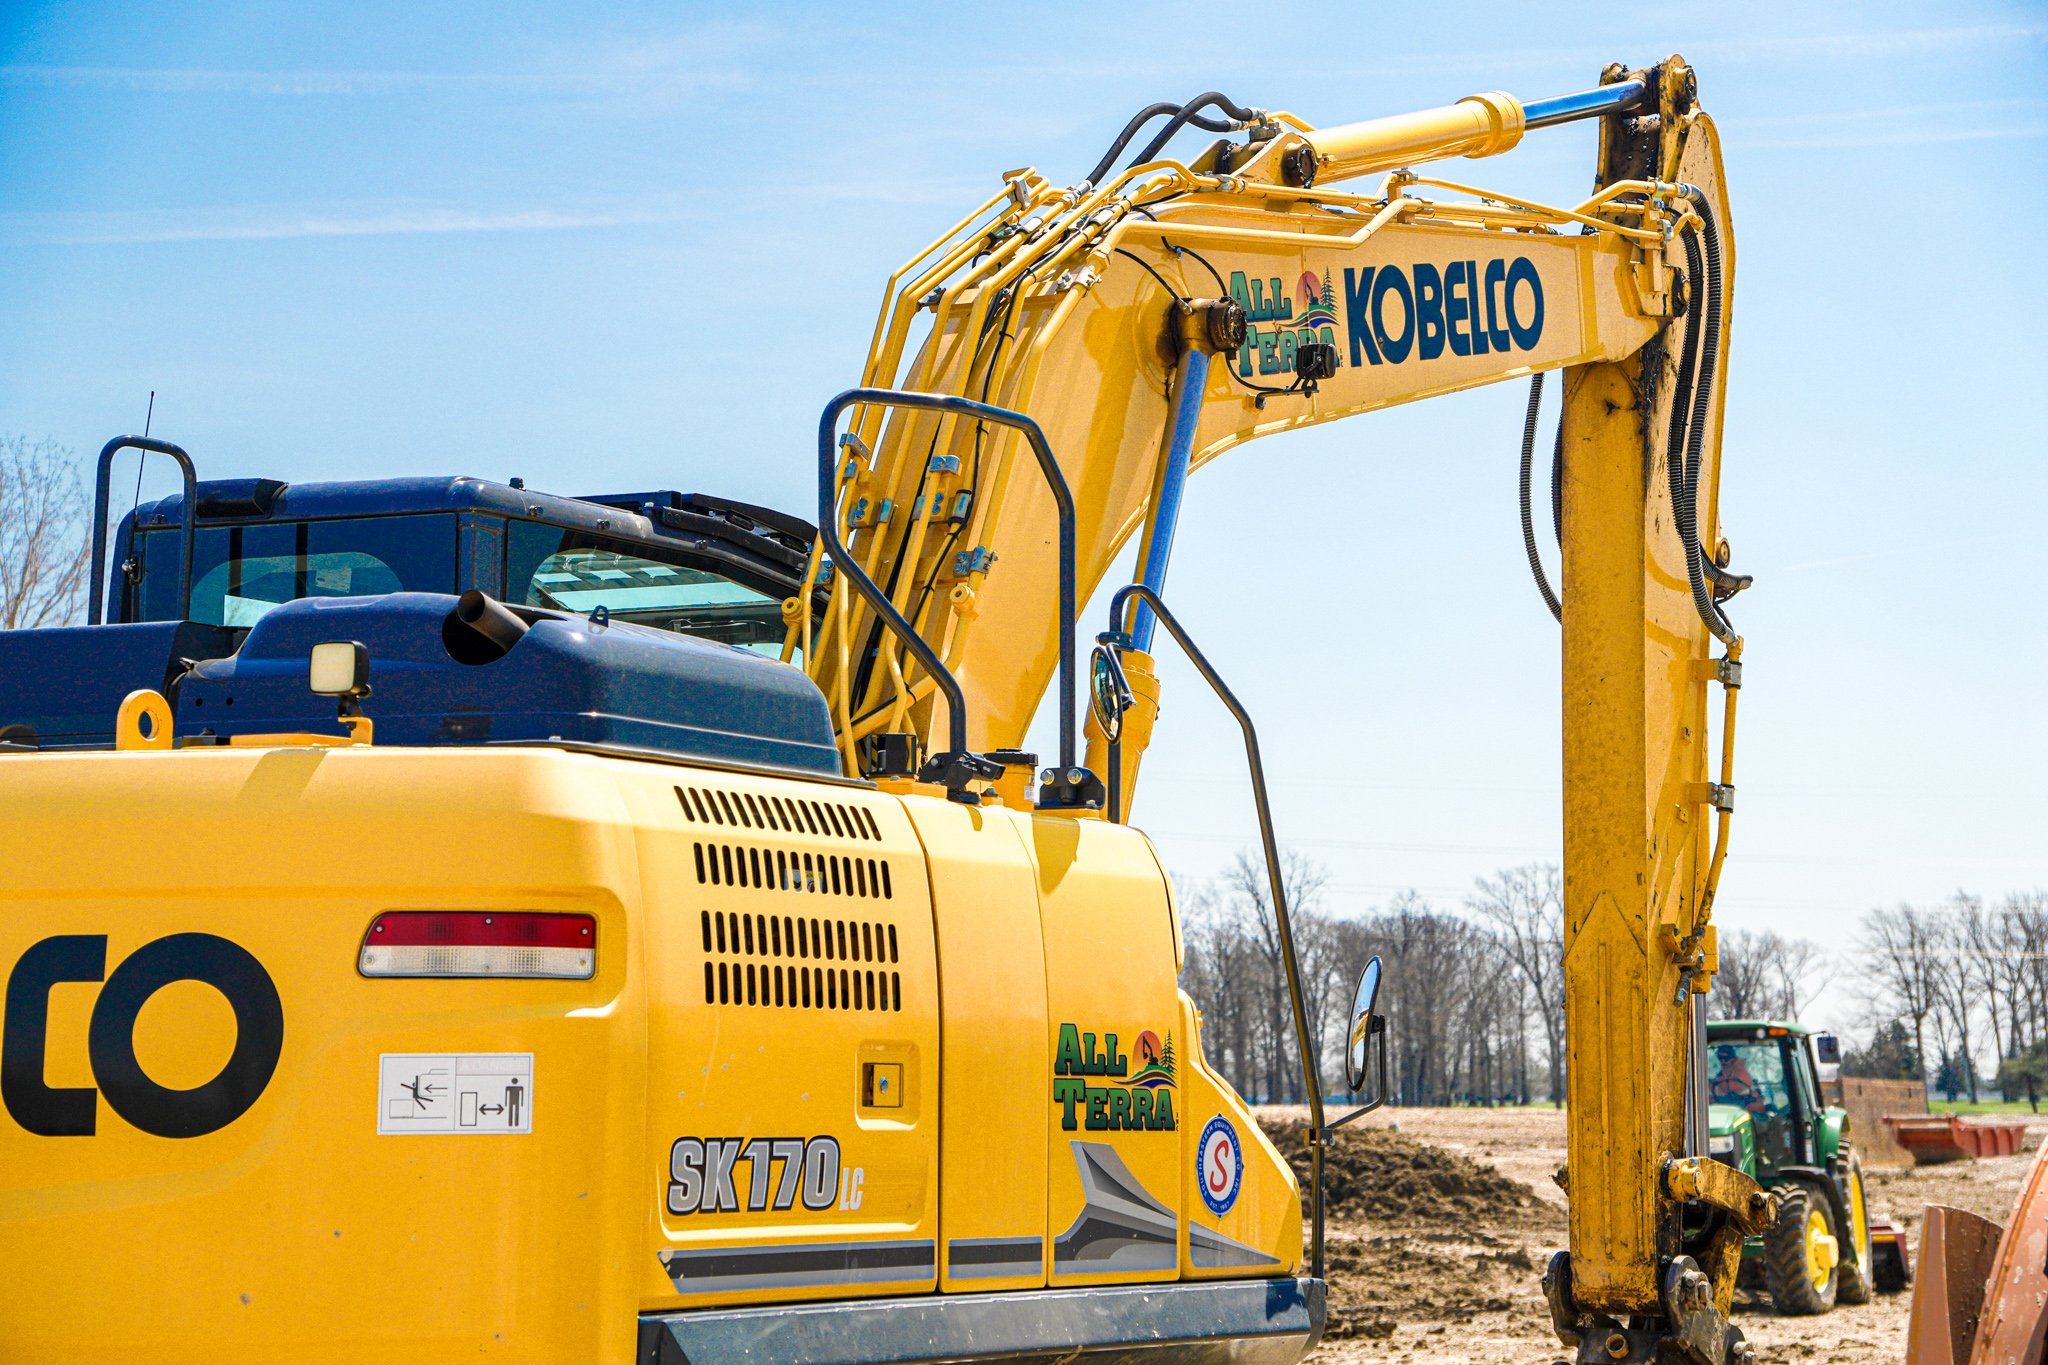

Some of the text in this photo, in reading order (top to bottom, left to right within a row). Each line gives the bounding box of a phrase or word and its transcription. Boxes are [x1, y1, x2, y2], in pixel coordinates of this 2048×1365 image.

[1230, 271, 1293, 323] ALL
[1343, 256, 1545, 368] KOBELCO
[0, 931, 284, 1139] CO
[1054, 1023, 1128, 1077] ALL
[1053, 1078, 1176, 1132] TERRA
[666, 1134, 865, 1216] SK170 LC
[1209, 1139, 1229, 1193] S
